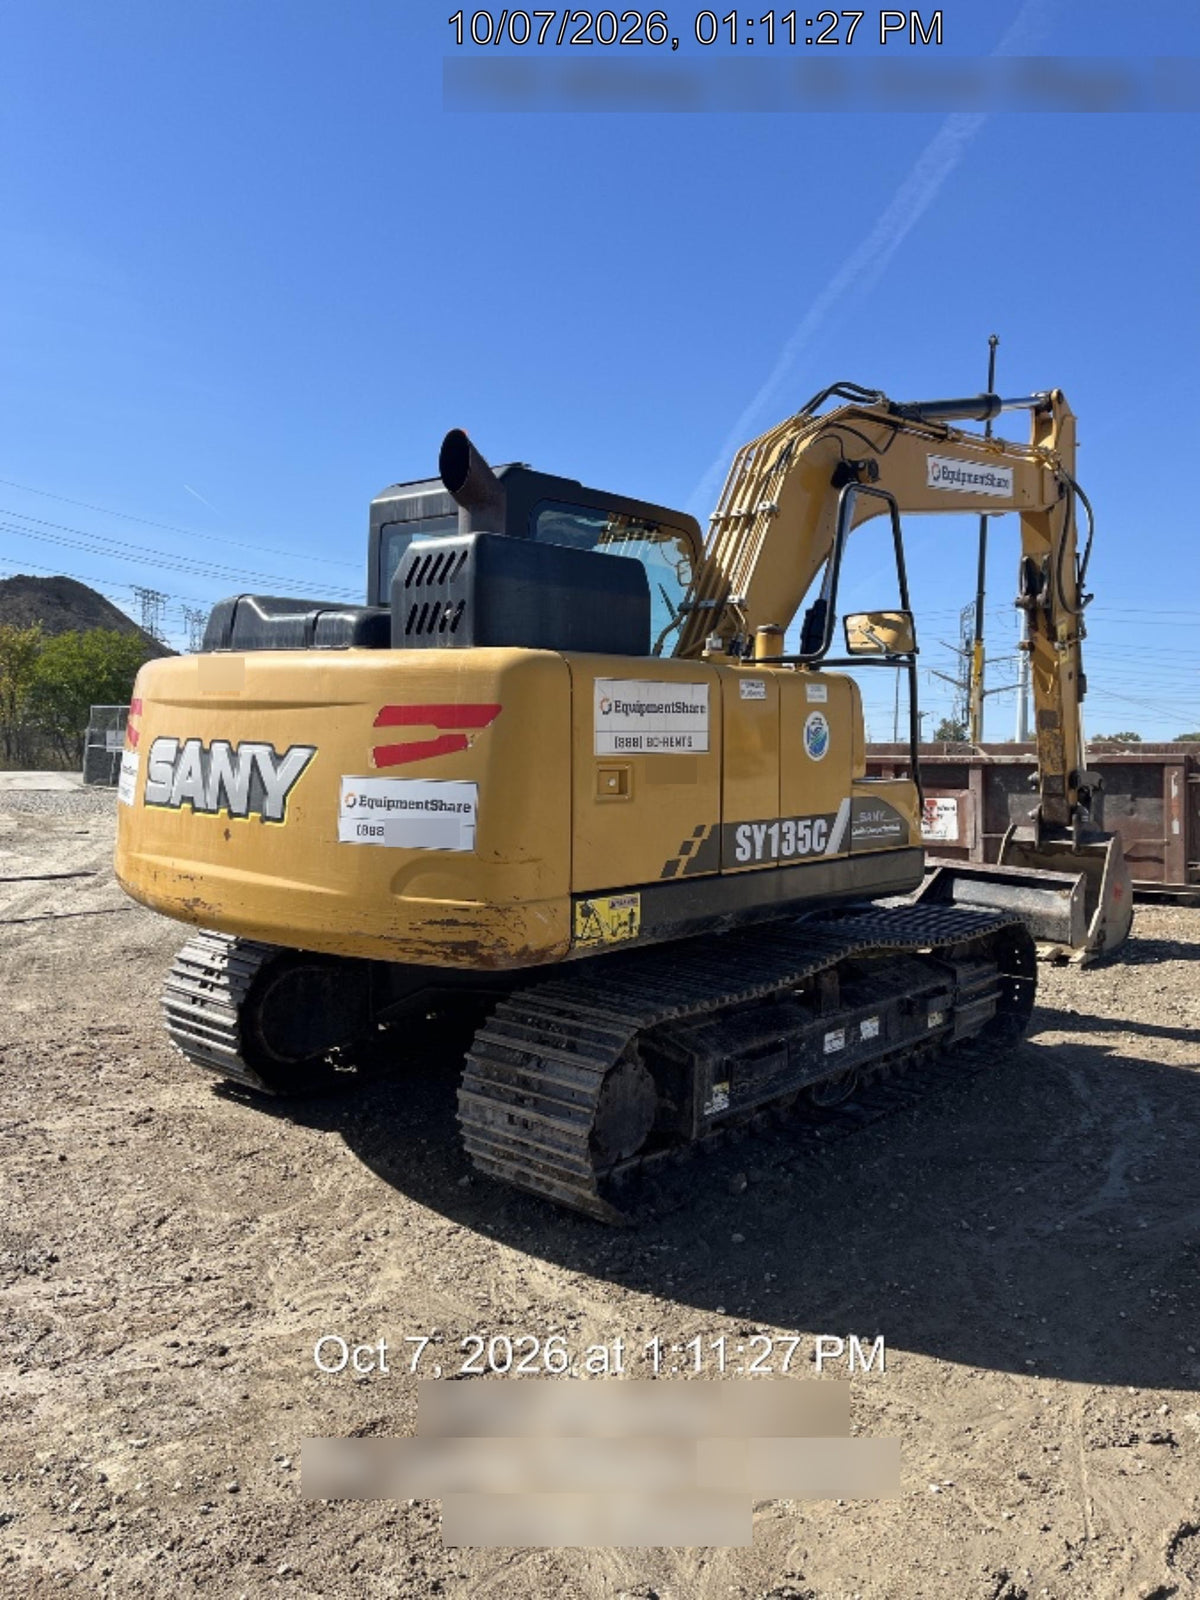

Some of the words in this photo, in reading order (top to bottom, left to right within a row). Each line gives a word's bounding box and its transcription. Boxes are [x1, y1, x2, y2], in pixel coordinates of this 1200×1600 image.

[144, 736, 319, 826] SANY
[359, 794, 472, 813] EquipmentShare
[735, 819, 828, 861] SY135C
